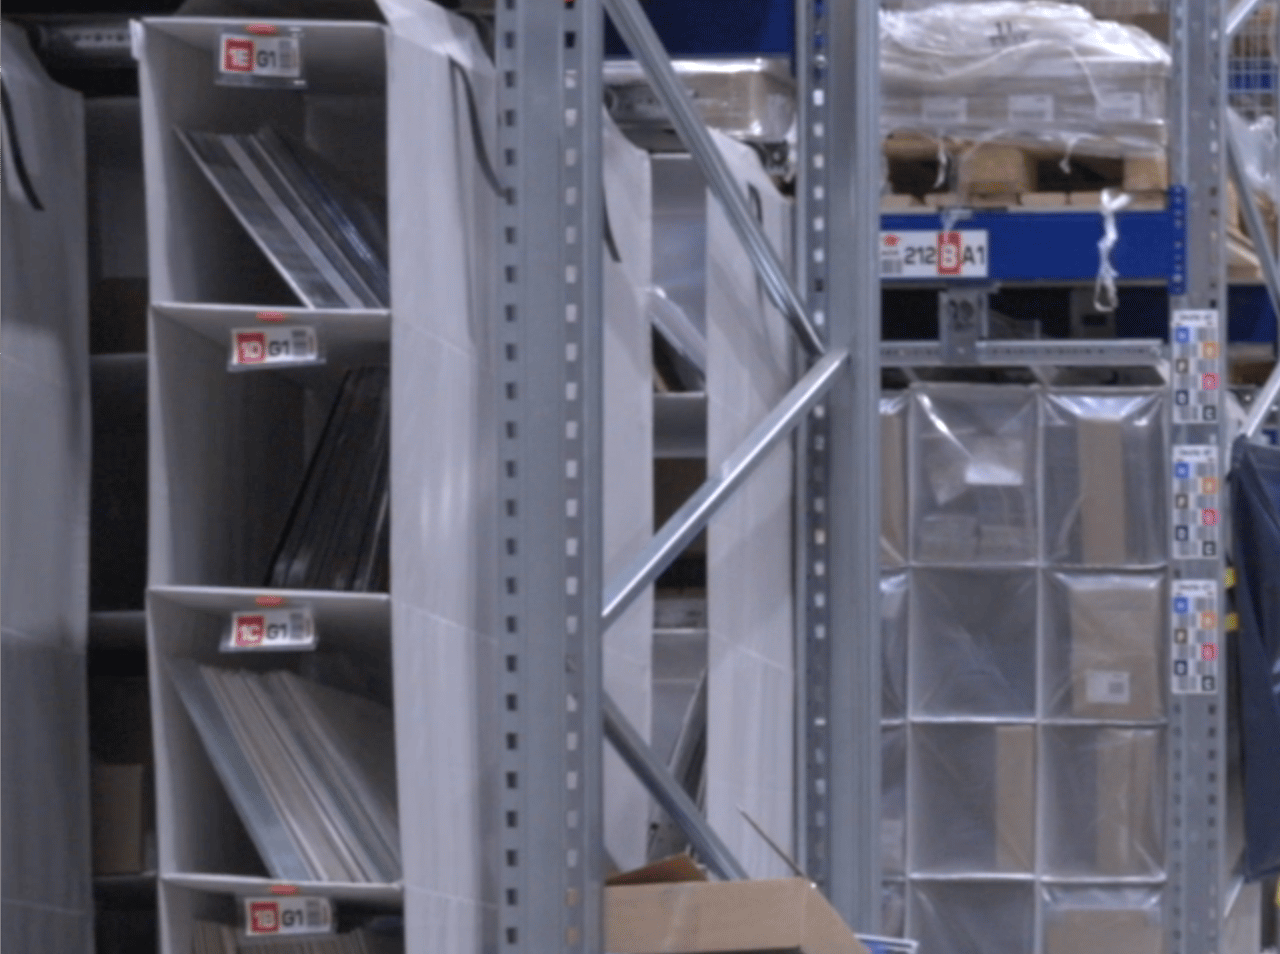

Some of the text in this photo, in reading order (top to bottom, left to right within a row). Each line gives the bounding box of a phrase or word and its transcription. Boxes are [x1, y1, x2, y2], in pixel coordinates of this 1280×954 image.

[257, 49, 277, 68] G1
[903, 246, 937, 265] 212
[963, 245, 986, 265] A1
[268, 340, 290, 357] G1
[266, 623, 288, 641] G1
[281, 908, 304, 928] G1
